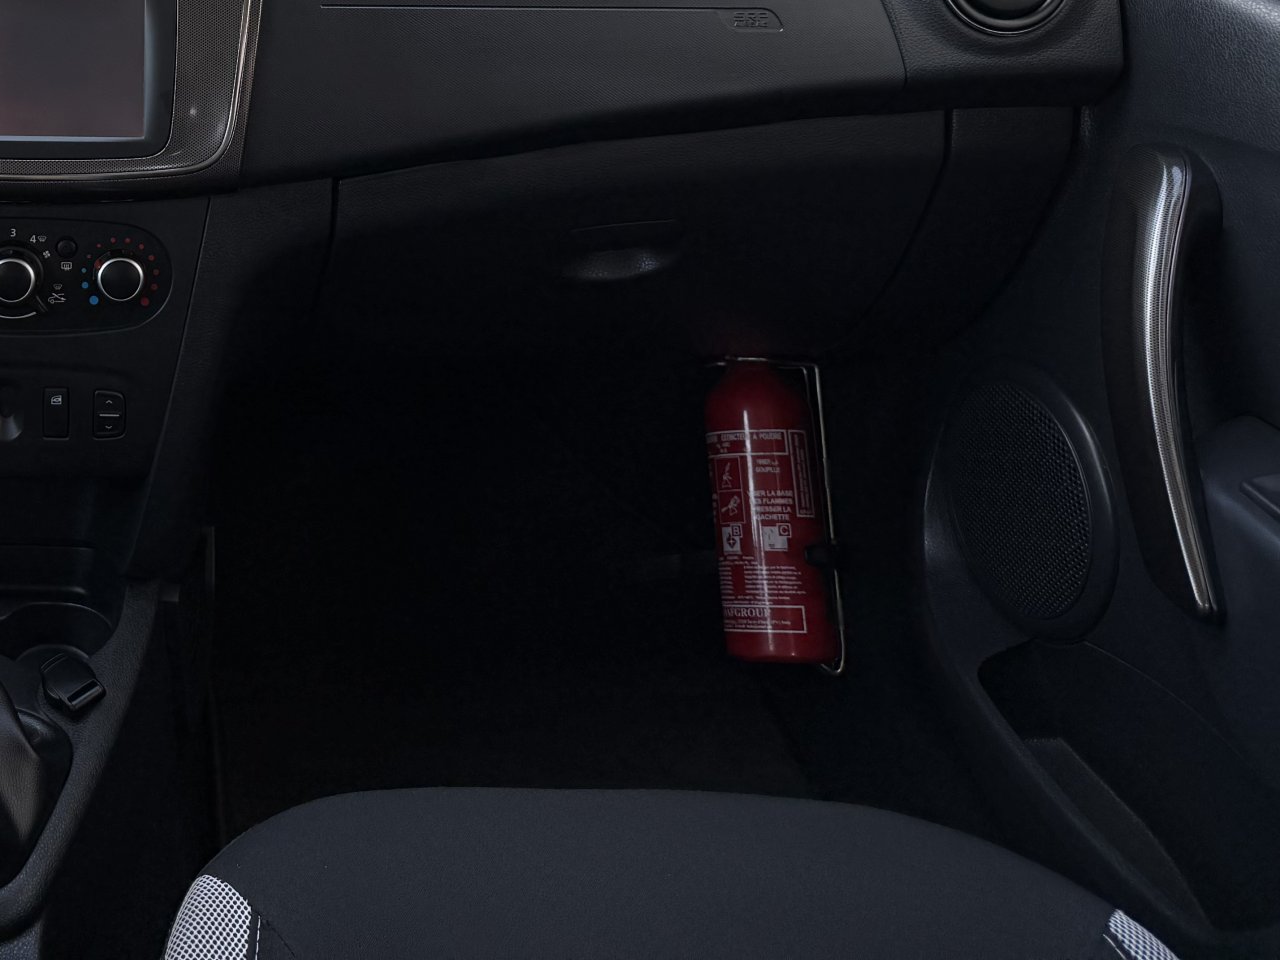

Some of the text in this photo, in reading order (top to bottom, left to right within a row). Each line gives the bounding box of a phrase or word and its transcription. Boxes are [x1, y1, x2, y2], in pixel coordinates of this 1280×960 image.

[10, 228, 17, 237] 3
[30, 234, 36, 243] 4
[779, 525, 789, 535] C
